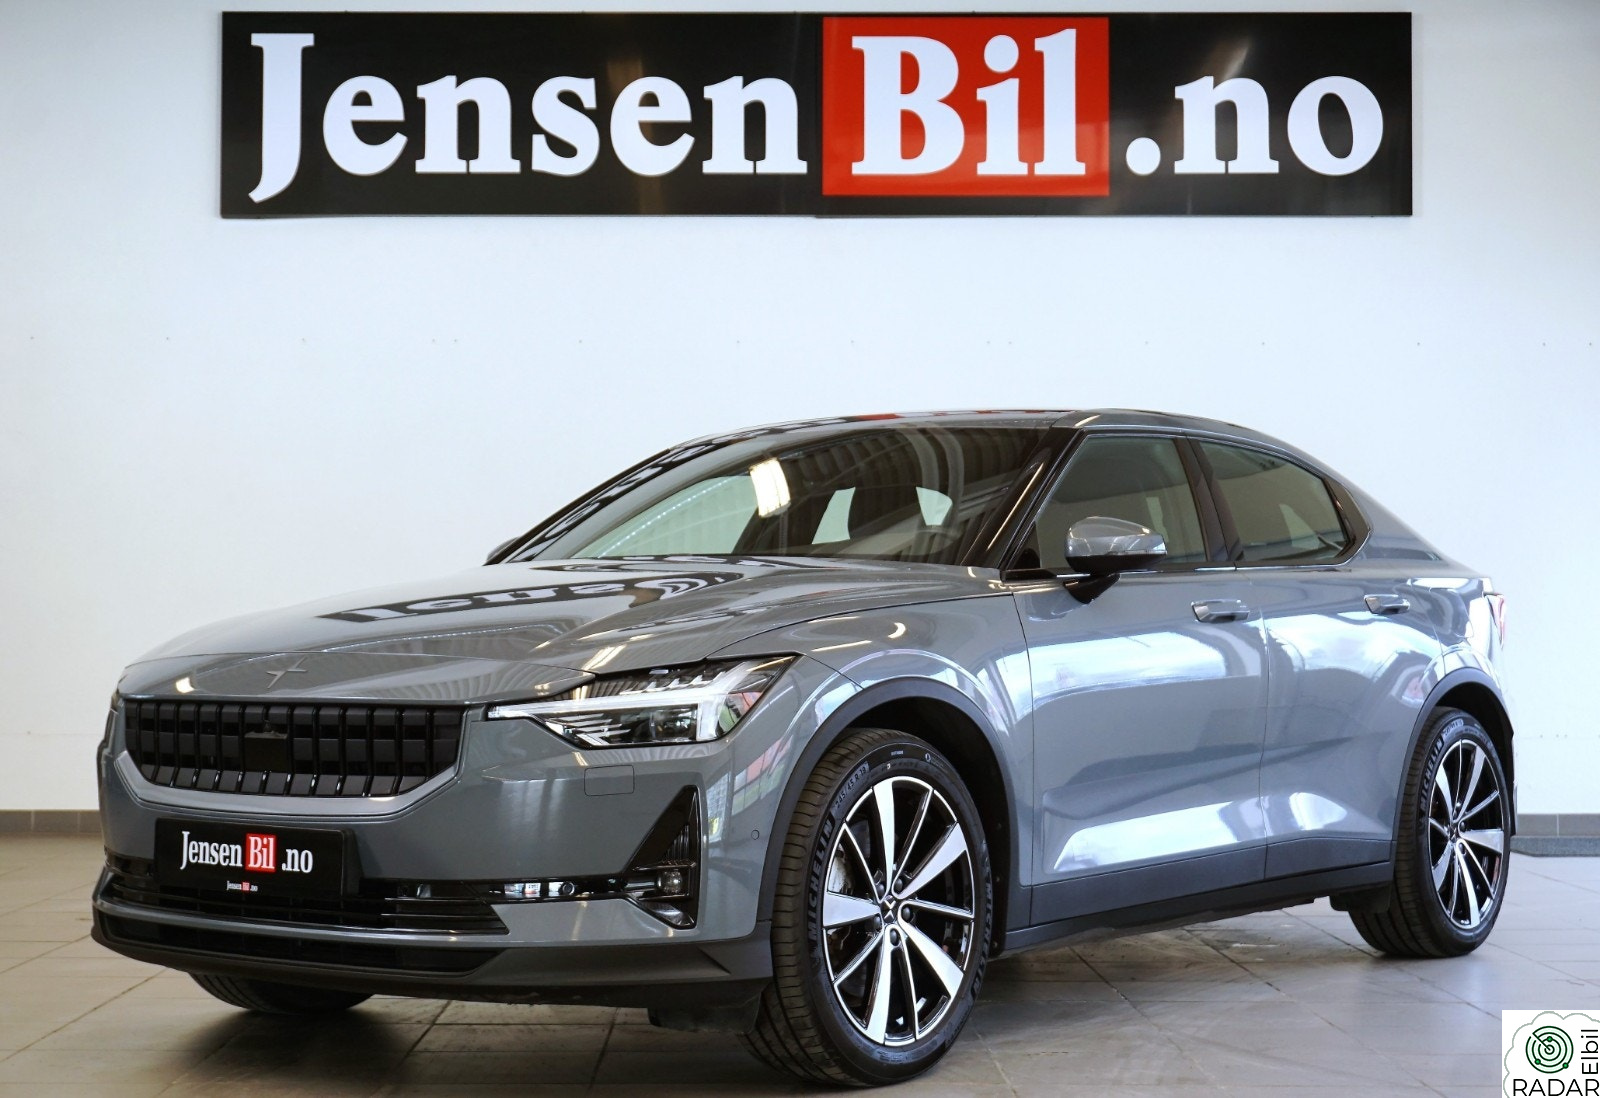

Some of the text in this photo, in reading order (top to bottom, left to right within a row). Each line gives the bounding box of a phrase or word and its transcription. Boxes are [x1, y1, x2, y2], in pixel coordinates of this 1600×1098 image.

[248, 28, 1384, 203] Jensen Bil .no
[1420, 738, 1443, 813] MICHELIN
[180, 830, 314, 874] Jensen Bil .no
[808, 818, 833, 941] MICHELIN
